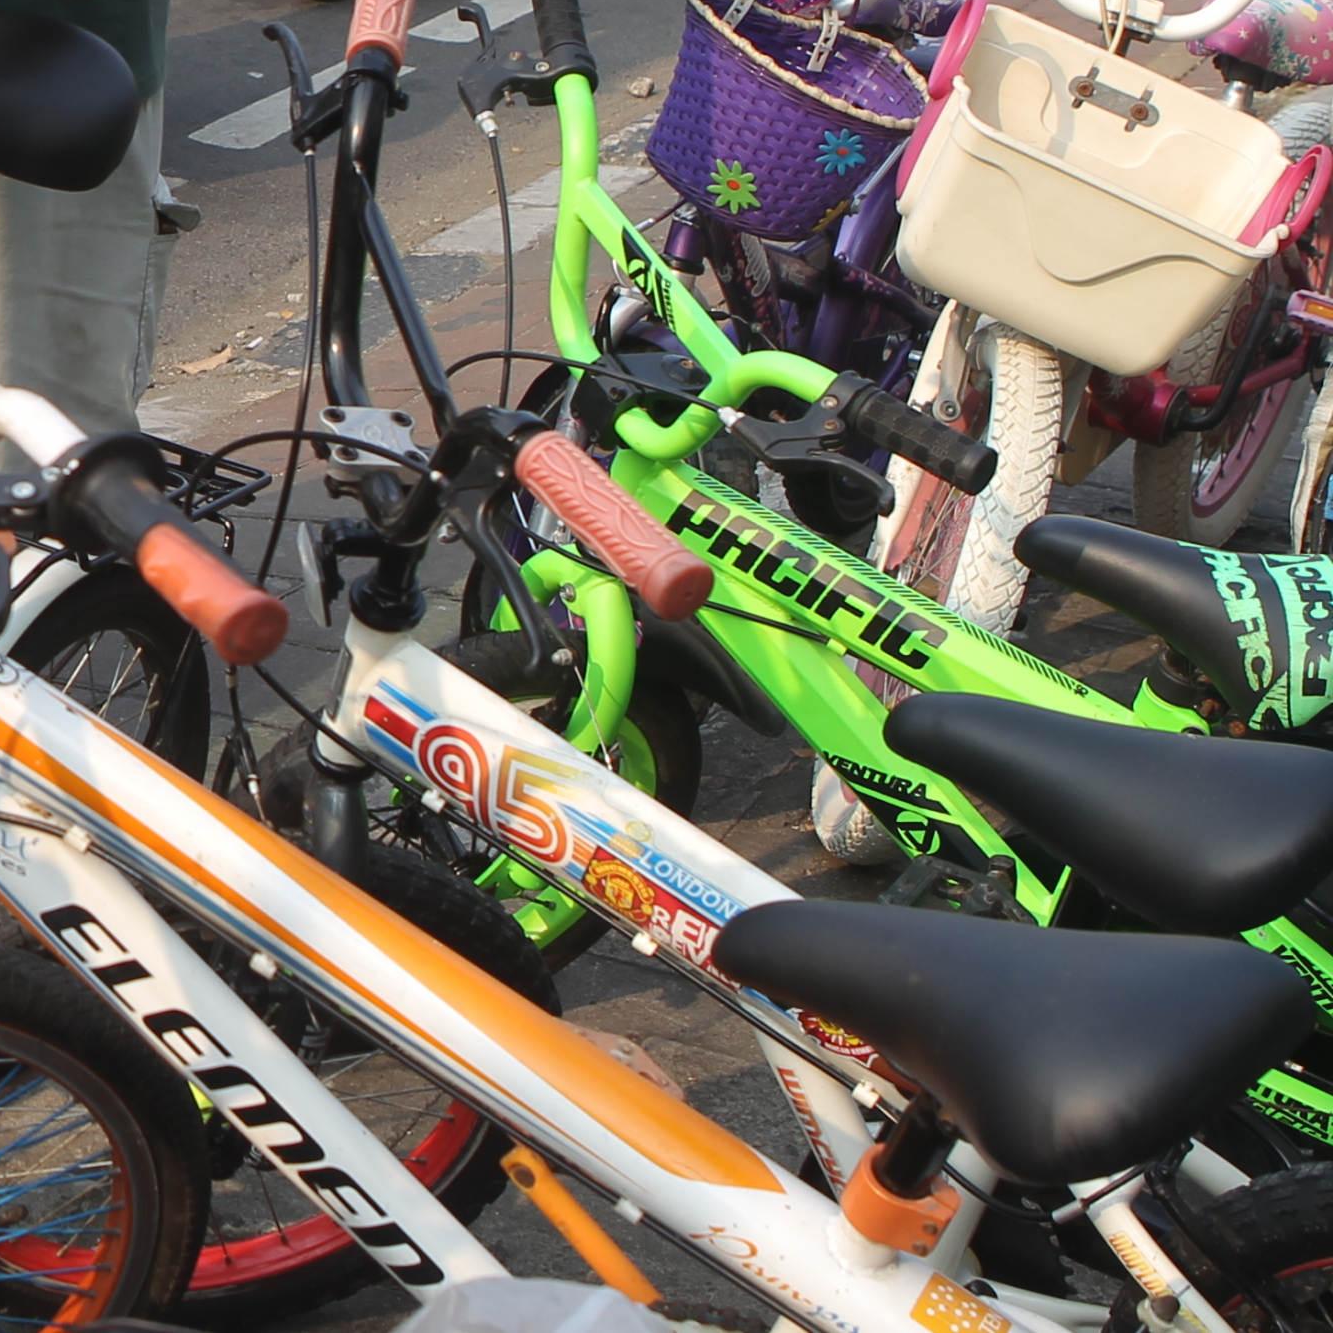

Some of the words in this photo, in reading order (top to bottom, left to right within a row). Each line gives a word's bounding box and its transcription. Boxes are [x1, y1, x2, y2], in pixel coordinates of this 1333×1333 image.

[666, 490, 948, 669] PACIFIC
[823, 750, 927, 799] VENTURA
[637, 849, 739, 918] LONDON
